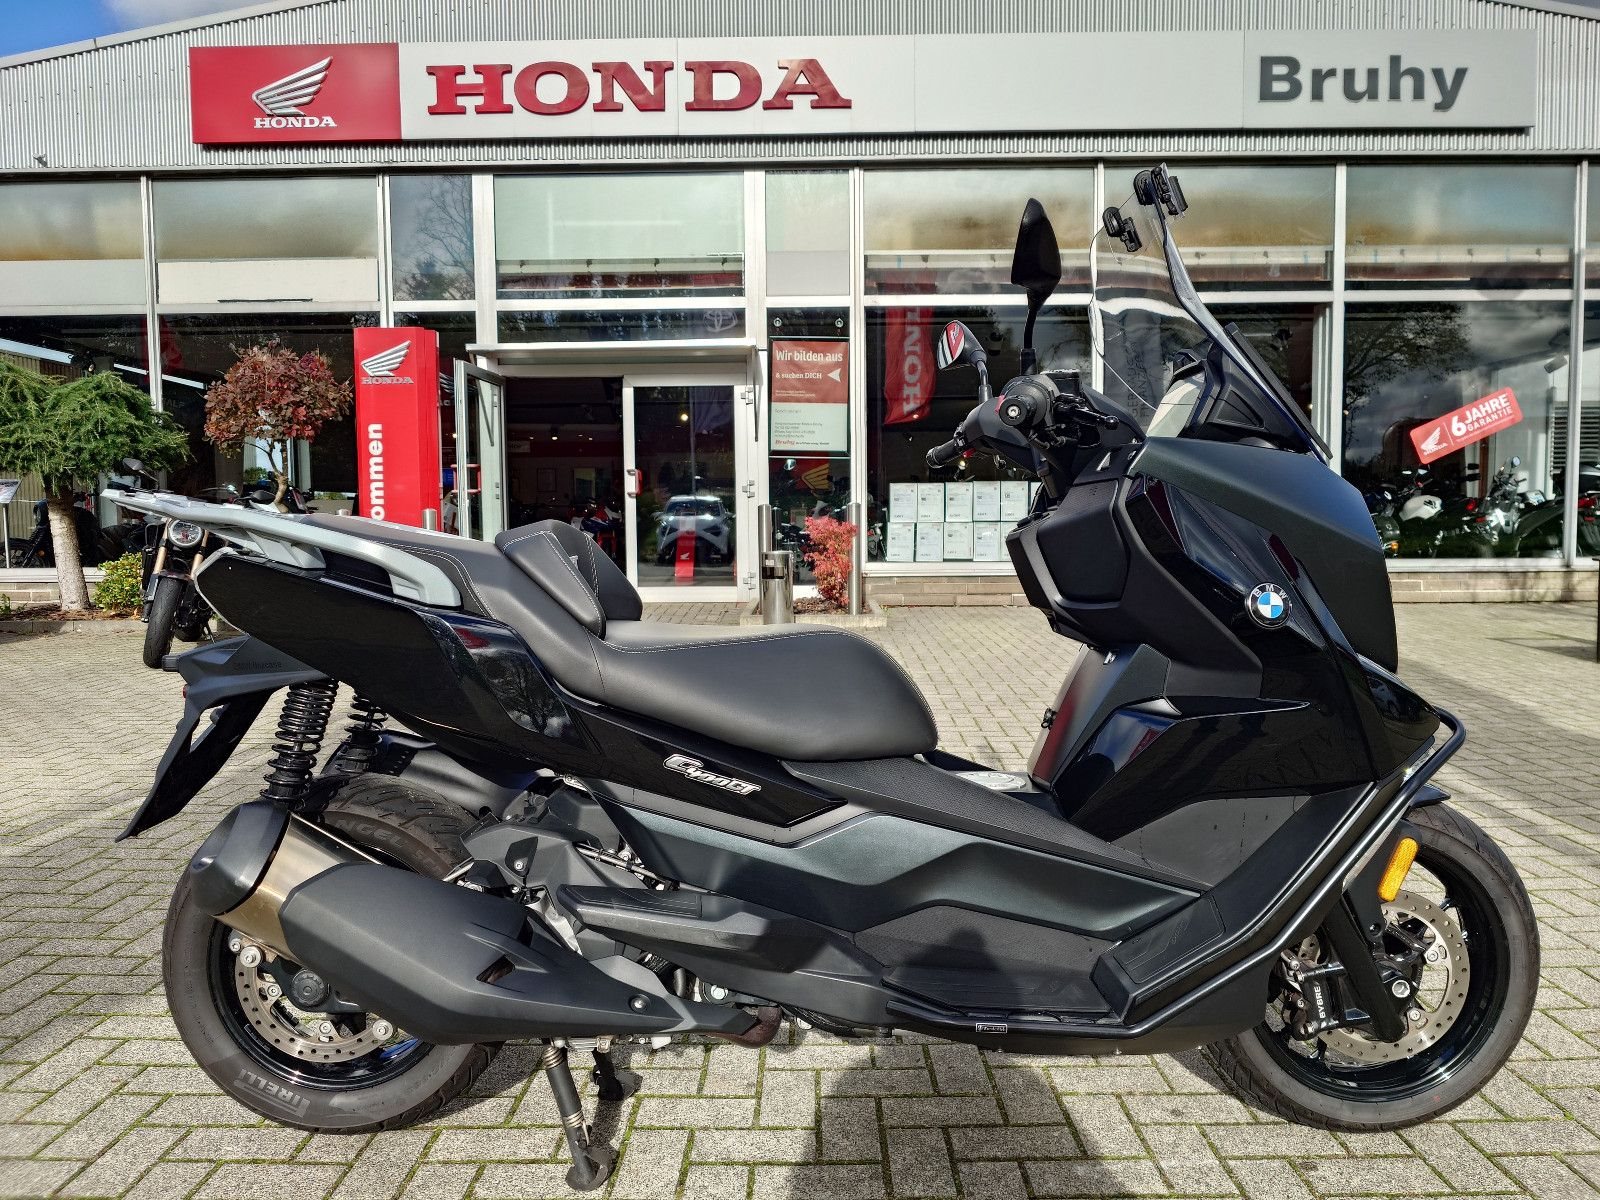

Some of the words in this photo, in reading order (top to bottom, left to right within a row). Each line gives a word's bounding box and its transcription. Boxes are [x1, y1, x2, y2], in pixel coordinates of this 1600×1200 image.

[427, 58, 852, 115] HONDA
[1258, 55, 1469, 113] Bruhy
[253, 116, 338, 129] HONDA
[776, 350, 792, 361] Wir
[794, 350, 823, 361] bilden
[825, 352, 843, 362] aus
[361, 376, 414, 385] HONDA
[1451, 415, 1467, 437] 6
[1463, 393, 1511, 424] JAHRE
[1467, 406, 1513, 432] GARANTIE
[1252, 584, 1288, 599] BMW
[1313, 985, 1327, 1019] BYBRE
[238, 1068, 311, 1117] PIRELLI
